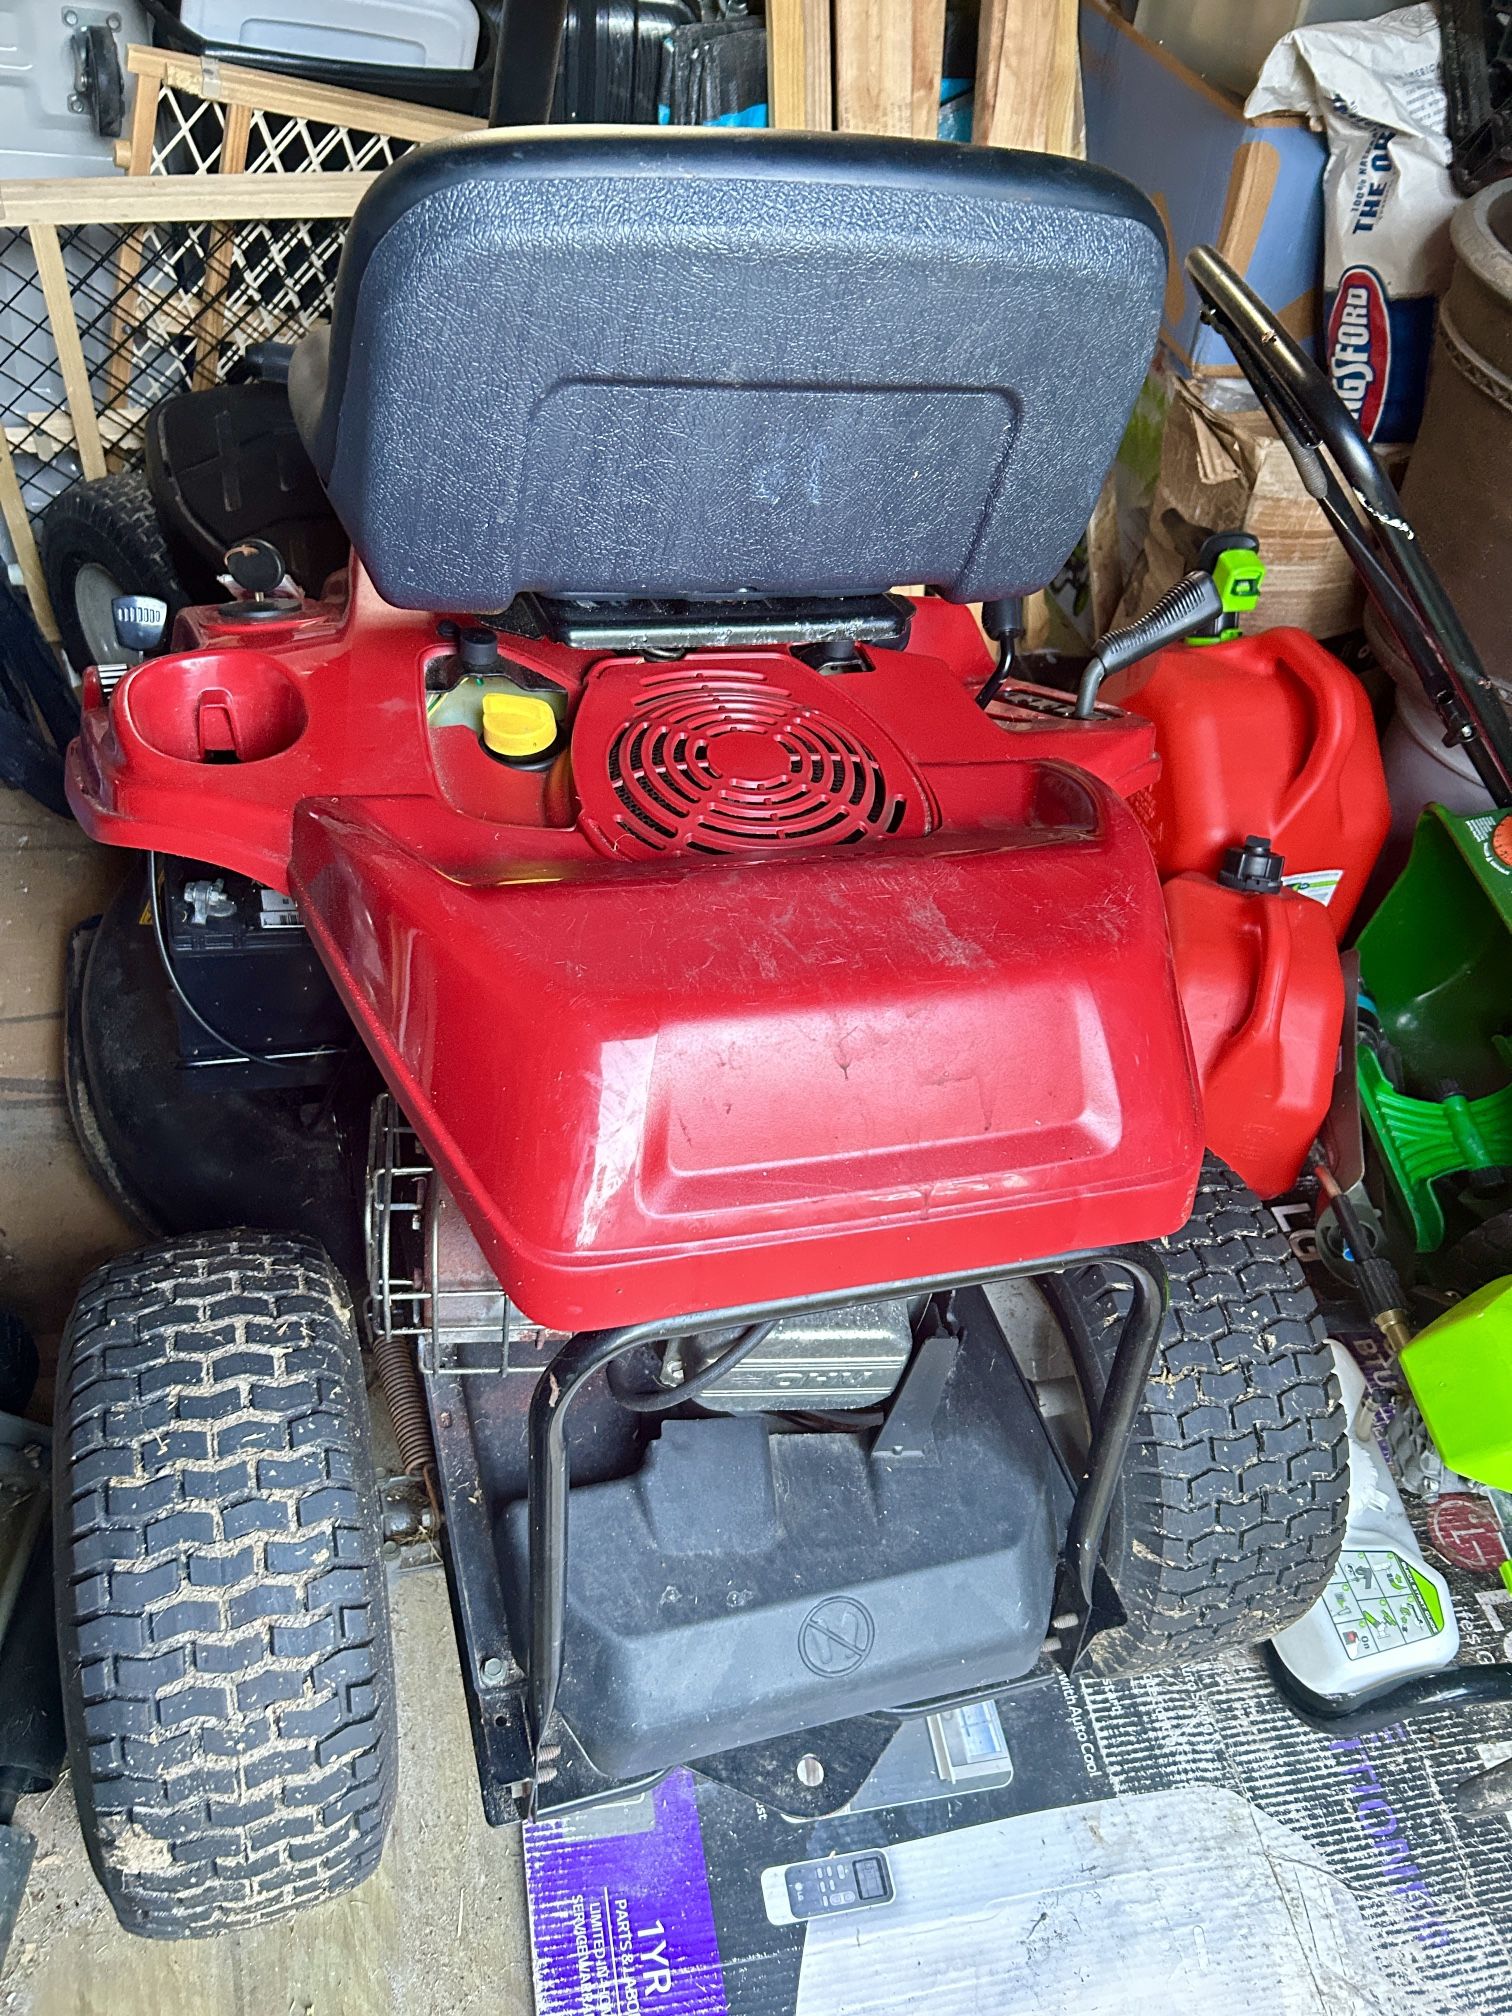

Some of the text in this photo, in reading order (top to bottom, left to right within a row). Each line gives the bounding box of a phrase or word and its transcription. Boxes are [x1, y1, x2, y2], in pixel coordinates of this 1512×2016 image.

[1350, 179, 1366, 212] 100%
[1353, 182, 1387, 234] THE
[1401, 1561, 1438, 1634] QUICK START GUIDE
[1361, 1636, 1370, 1649] On
[1059, 1673, 1102, 1777] with Auto Cool
[571, 1895, 590, 1956] SERVICE
[589, 1902, 606, 1958] LIMITED
[615, 1900, 633, 1951] PARTS
[620, 1953, 634, 1965] &
